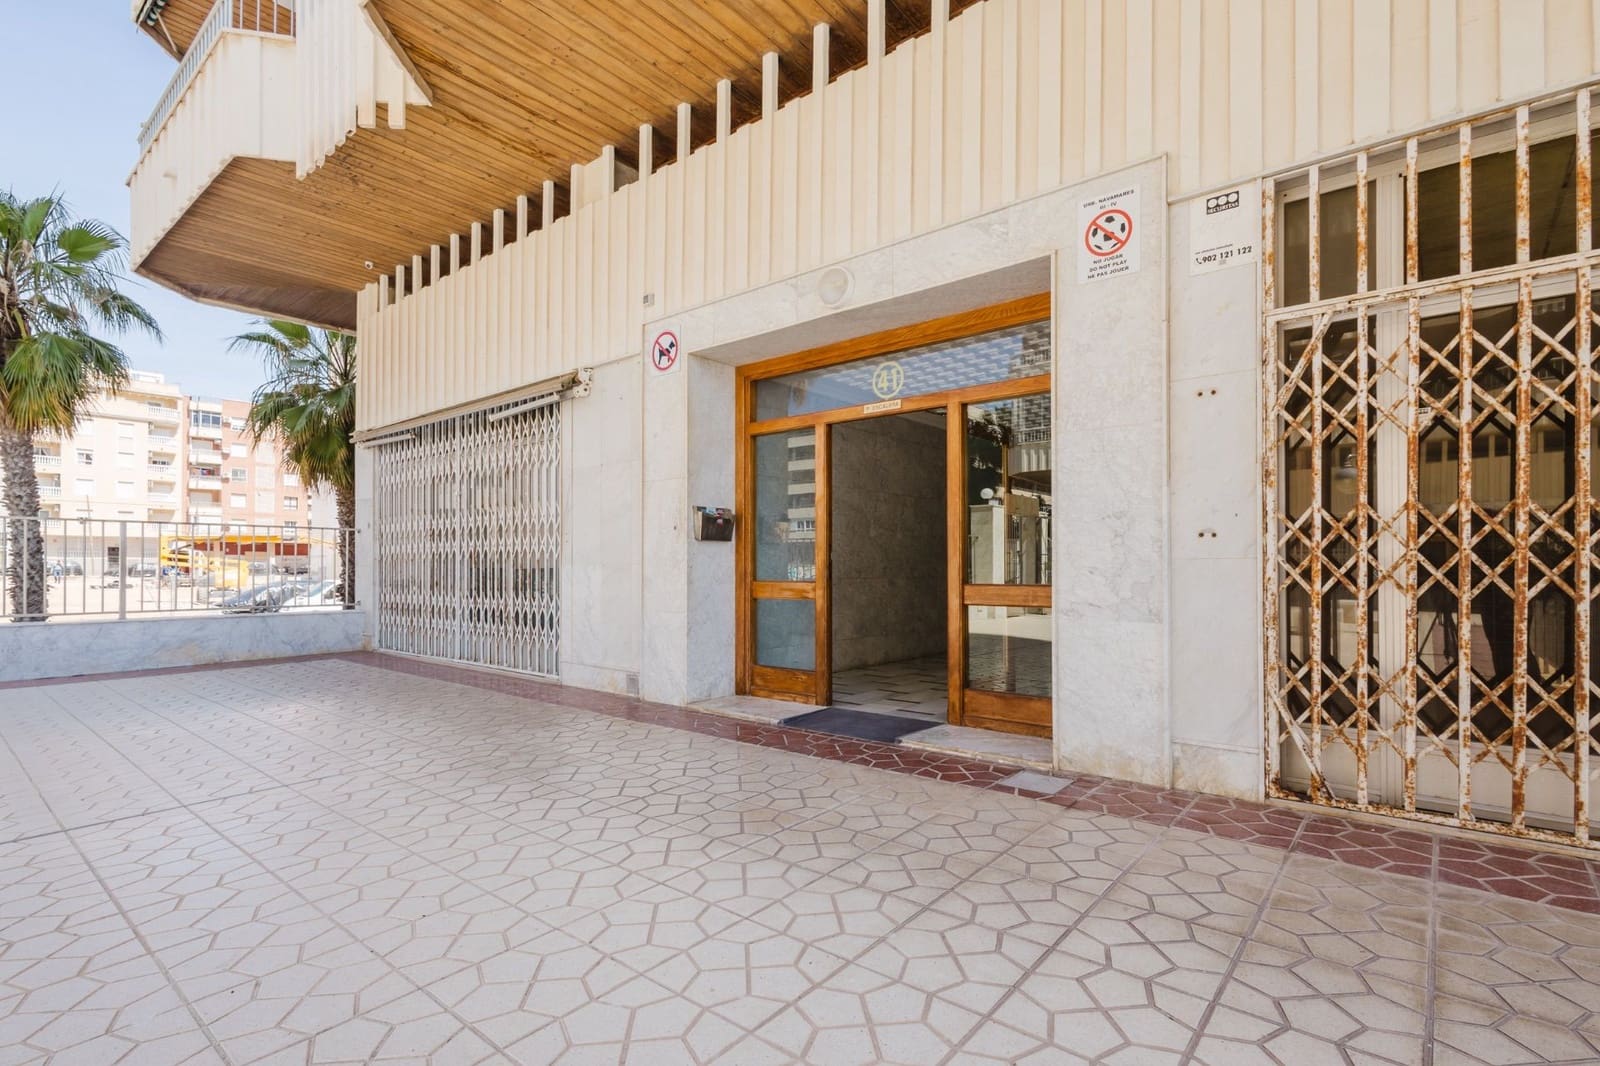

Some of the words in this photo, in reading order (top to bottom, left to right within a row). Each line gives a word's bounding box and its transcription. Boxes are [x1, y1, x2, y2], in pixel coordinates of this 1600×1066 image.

[1103, 253, 1123, 262] JUGAR
[1202, 254, 1217, 263] 902
[1220, 249, 1233, 259] 121
[1238, 245, 1252, 255] 122
[1110, 265, 1129, 274] JOUER
[878, 367, 898, 391] 41
